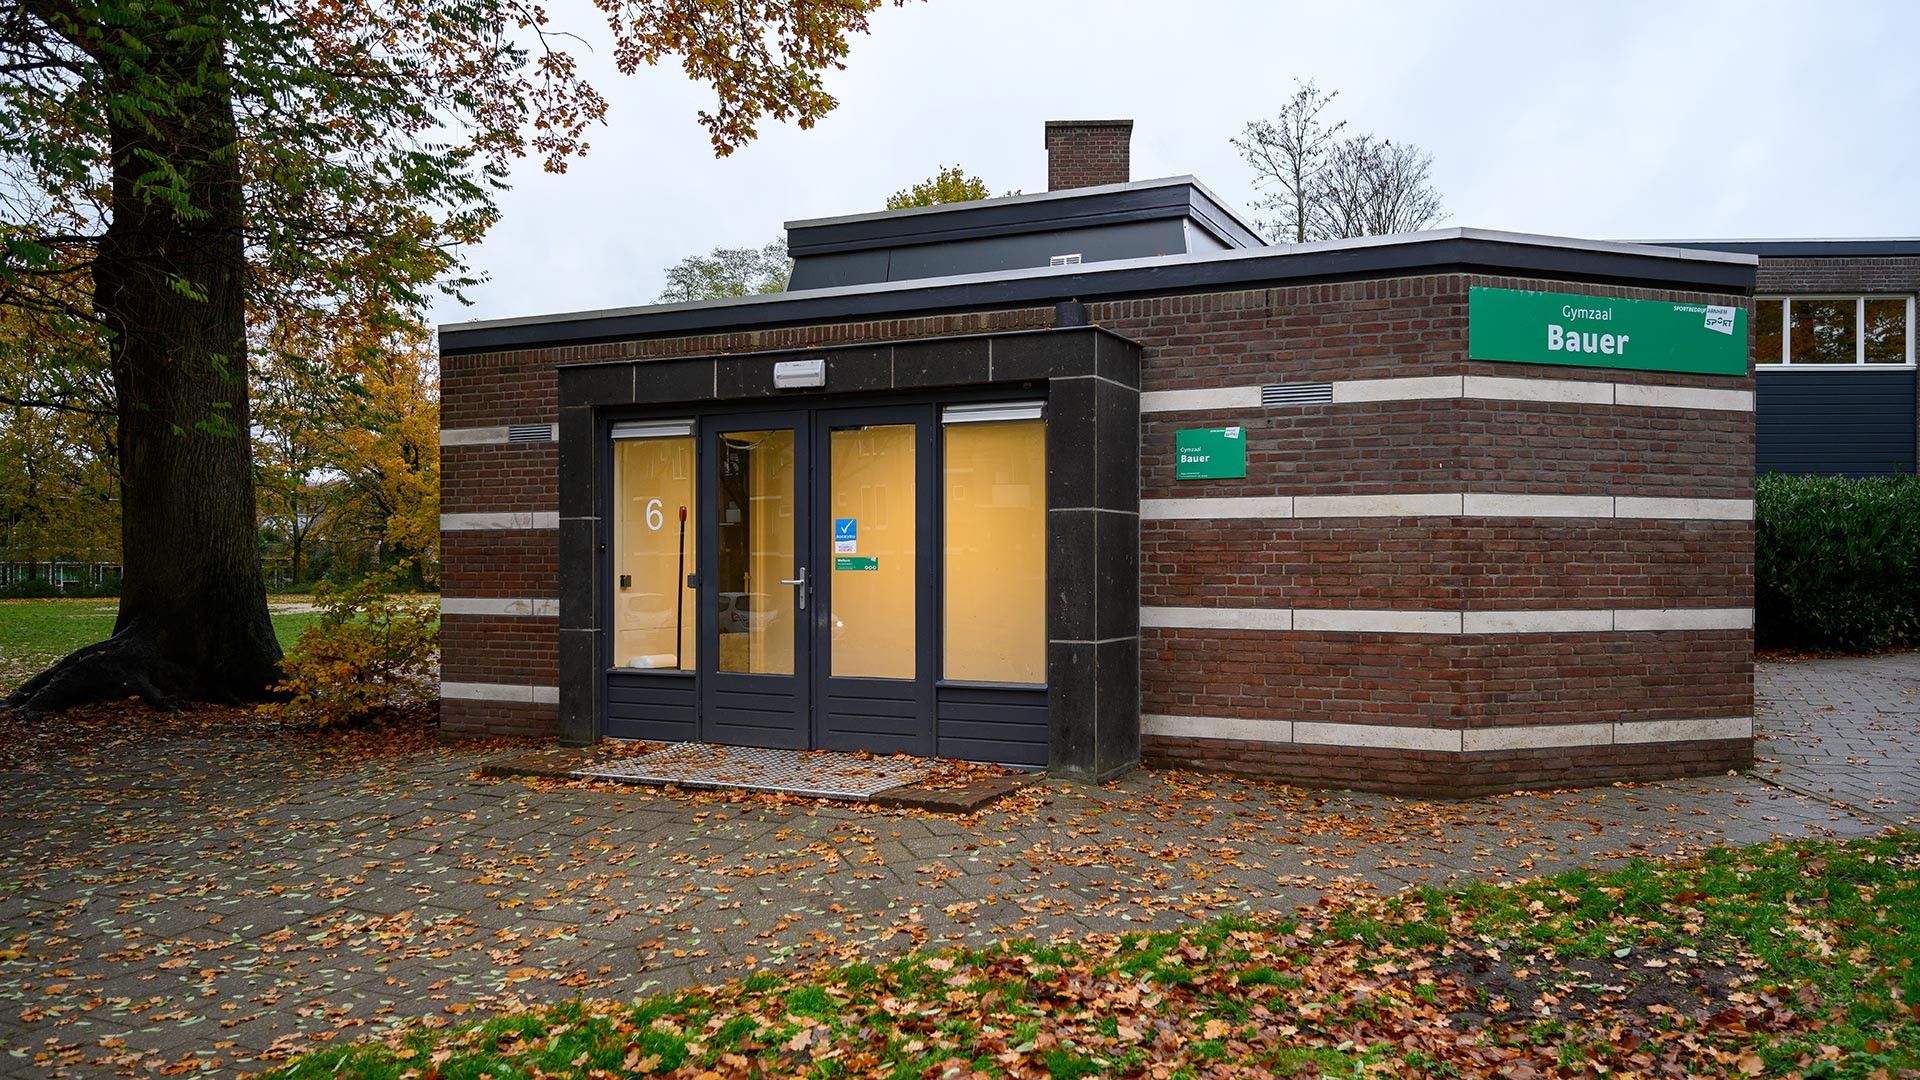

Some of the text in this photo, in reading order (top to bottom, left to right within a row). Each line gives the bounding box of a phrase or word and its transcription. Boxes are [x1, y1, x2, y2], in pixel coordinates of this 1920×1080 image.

[1562, 305, 1612, 321] Gymzaal
[1706, 317, 1733, 327] SPORT
[1547, 324, 1630, 355] Bauer
[1180, 454, 1211, 463] Bauer
[646, 499, 663, 531] 6
